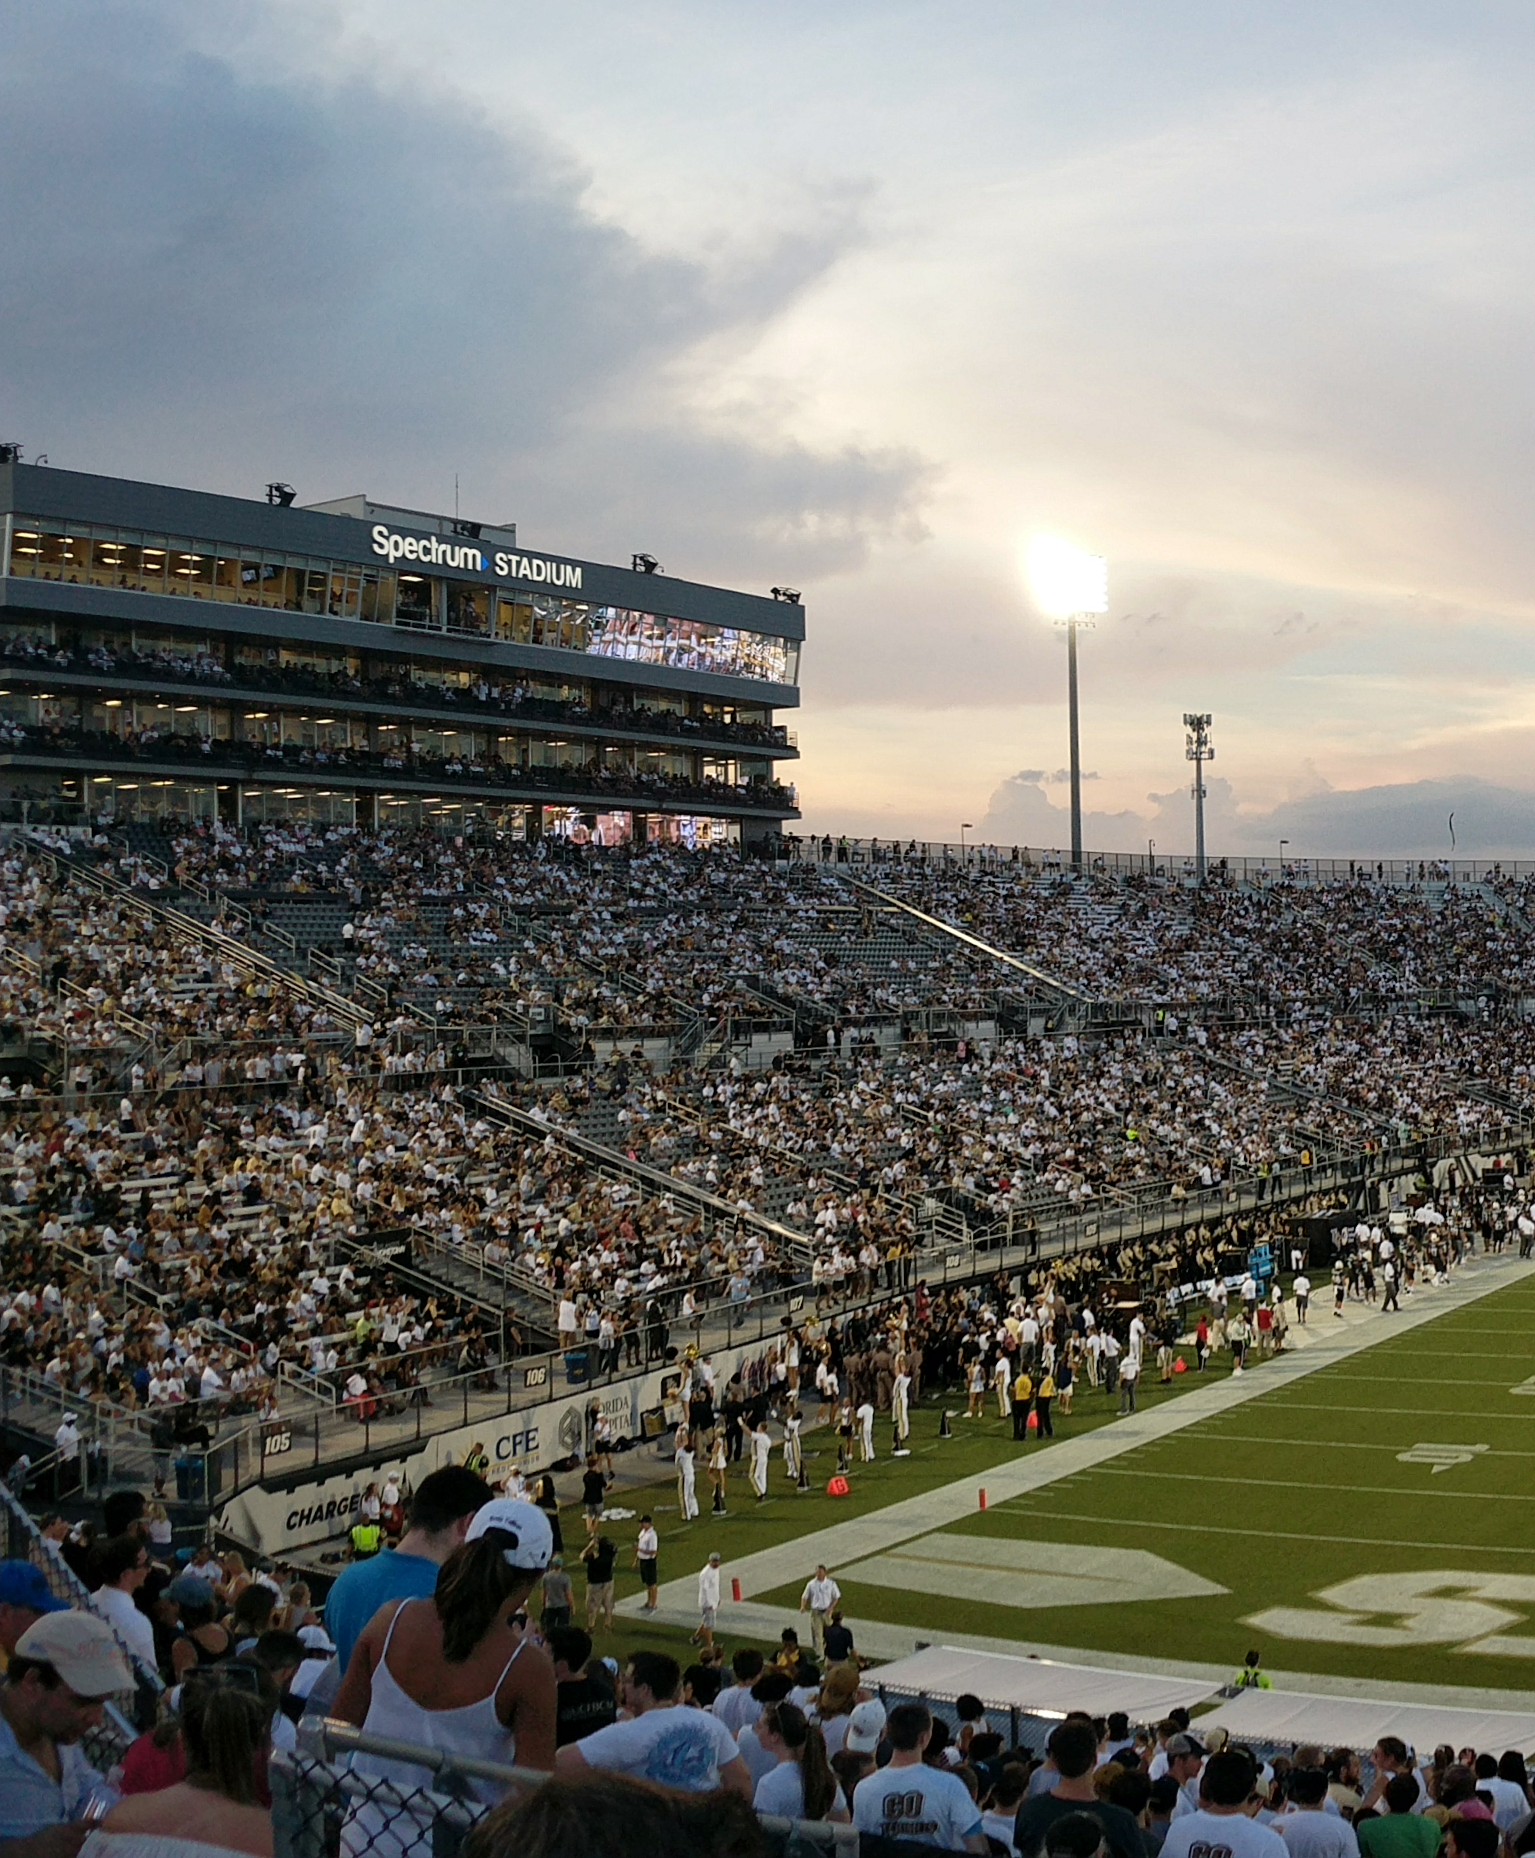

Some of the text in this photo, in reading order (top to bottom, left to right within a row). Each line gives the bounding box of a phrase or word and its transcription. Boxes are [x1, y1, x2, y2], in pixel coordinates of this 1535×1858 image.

[372, 525, 583, 589] Spectrum STADIUM
[789, 1295, 804, 1313] 107
[525, 1368, 546, 1386] 106
[264, 1431, 291, 1455] 105
[495, 1427, 540, 1461] CFE
[1395, 1442, 1491, 1465] 10
[286, 1492, 364, 1531] CHARGE
[882, 1789, 925, 1821] GO
